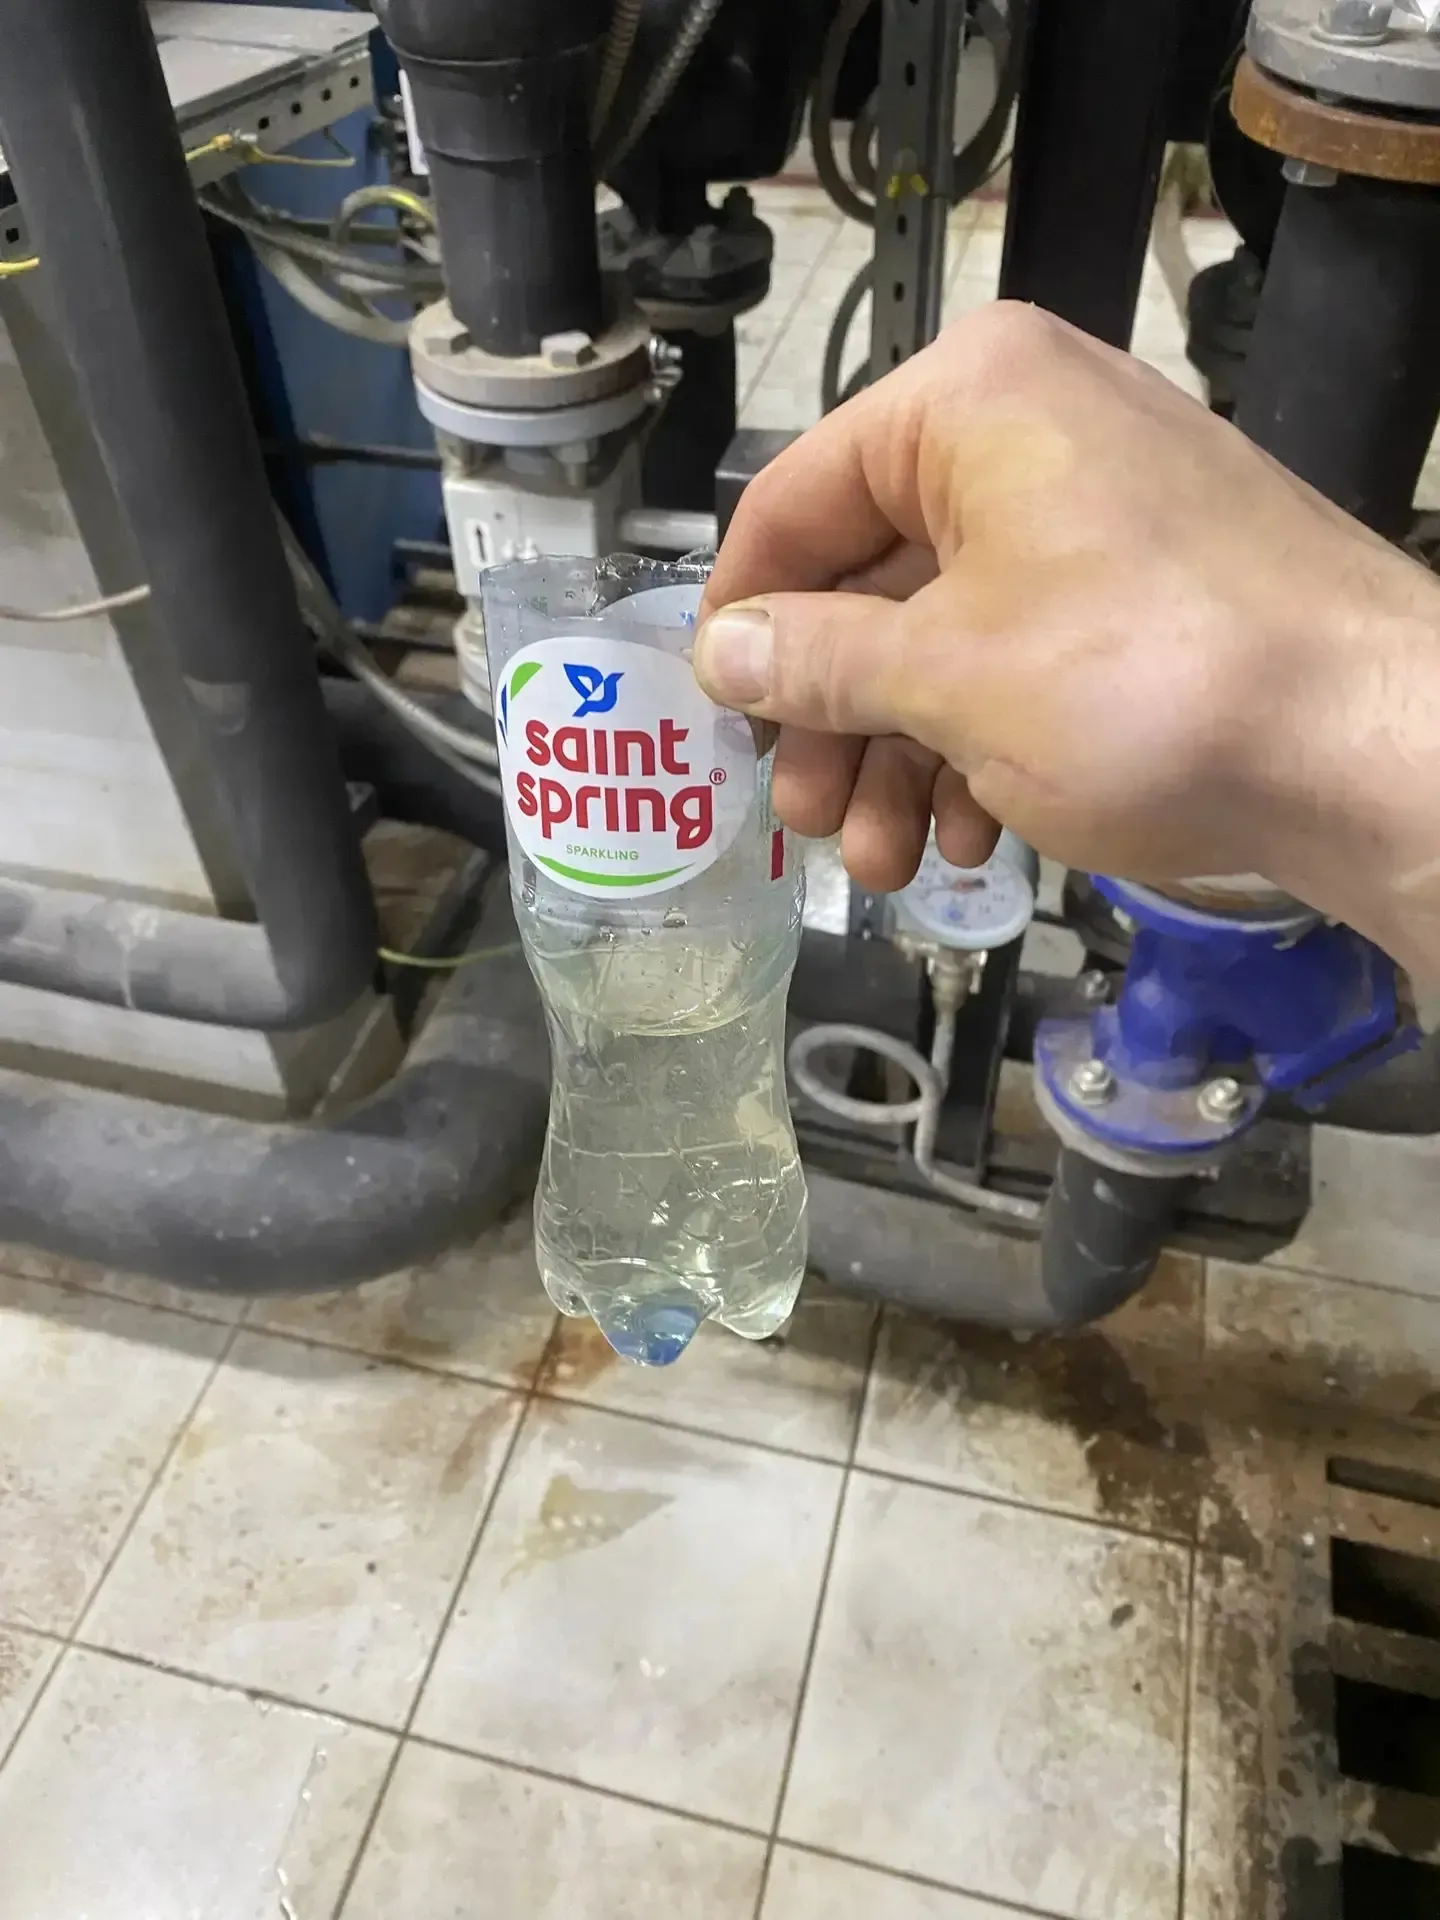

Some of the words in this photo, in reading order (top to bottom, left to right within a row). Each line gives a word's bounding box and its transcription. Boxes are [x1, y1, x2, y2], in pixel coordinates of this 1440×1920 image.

[525, 719, 690, 777] saint
[516, 771, 714, 850] spring
[565, 843, 640, 861] SPARKLING
